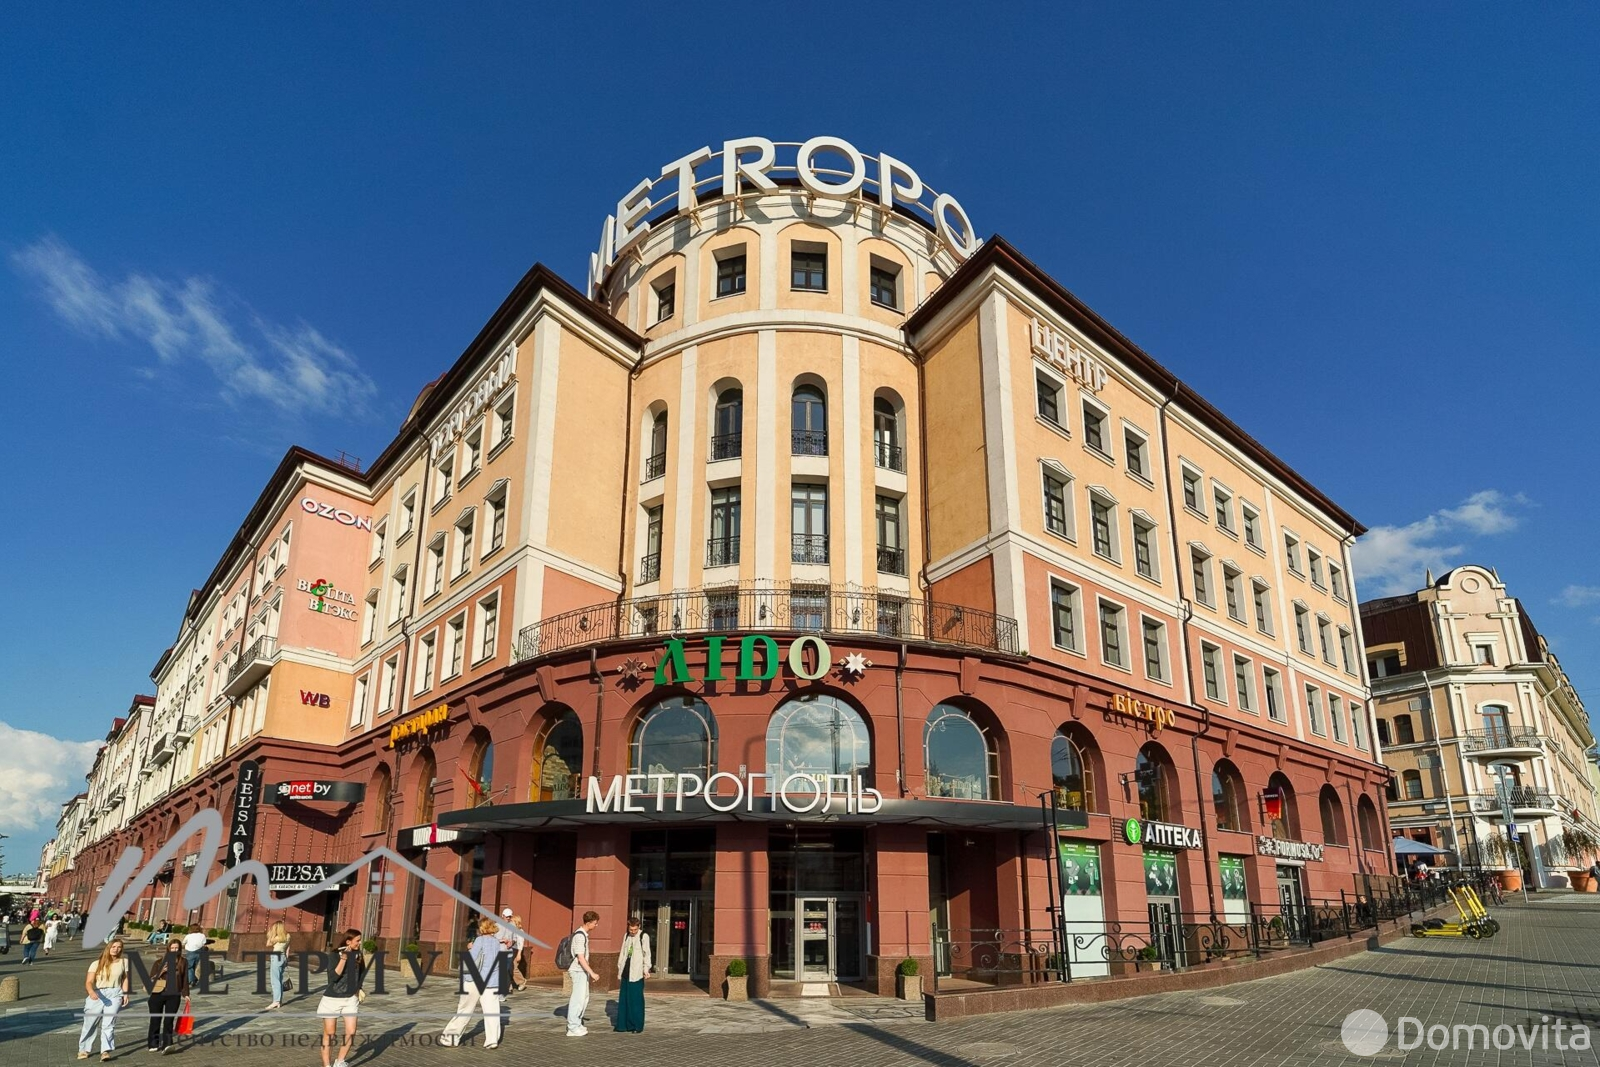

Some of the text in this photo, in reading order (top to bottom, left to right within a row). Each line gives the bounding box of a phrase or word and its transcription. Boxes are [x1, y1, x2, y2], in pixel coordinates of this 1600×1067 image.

[587, 135, 984, 302] METROPO
[1030, 317, 1109, 392] ЦЕНТР
[301, 497, 373, 533] OZON
[300, 689, 331, 709] WB
[585, 771, 883, 814] МЕТРОПОЛЬ
[1145, 823, 1202, 848] АПТЕКА
